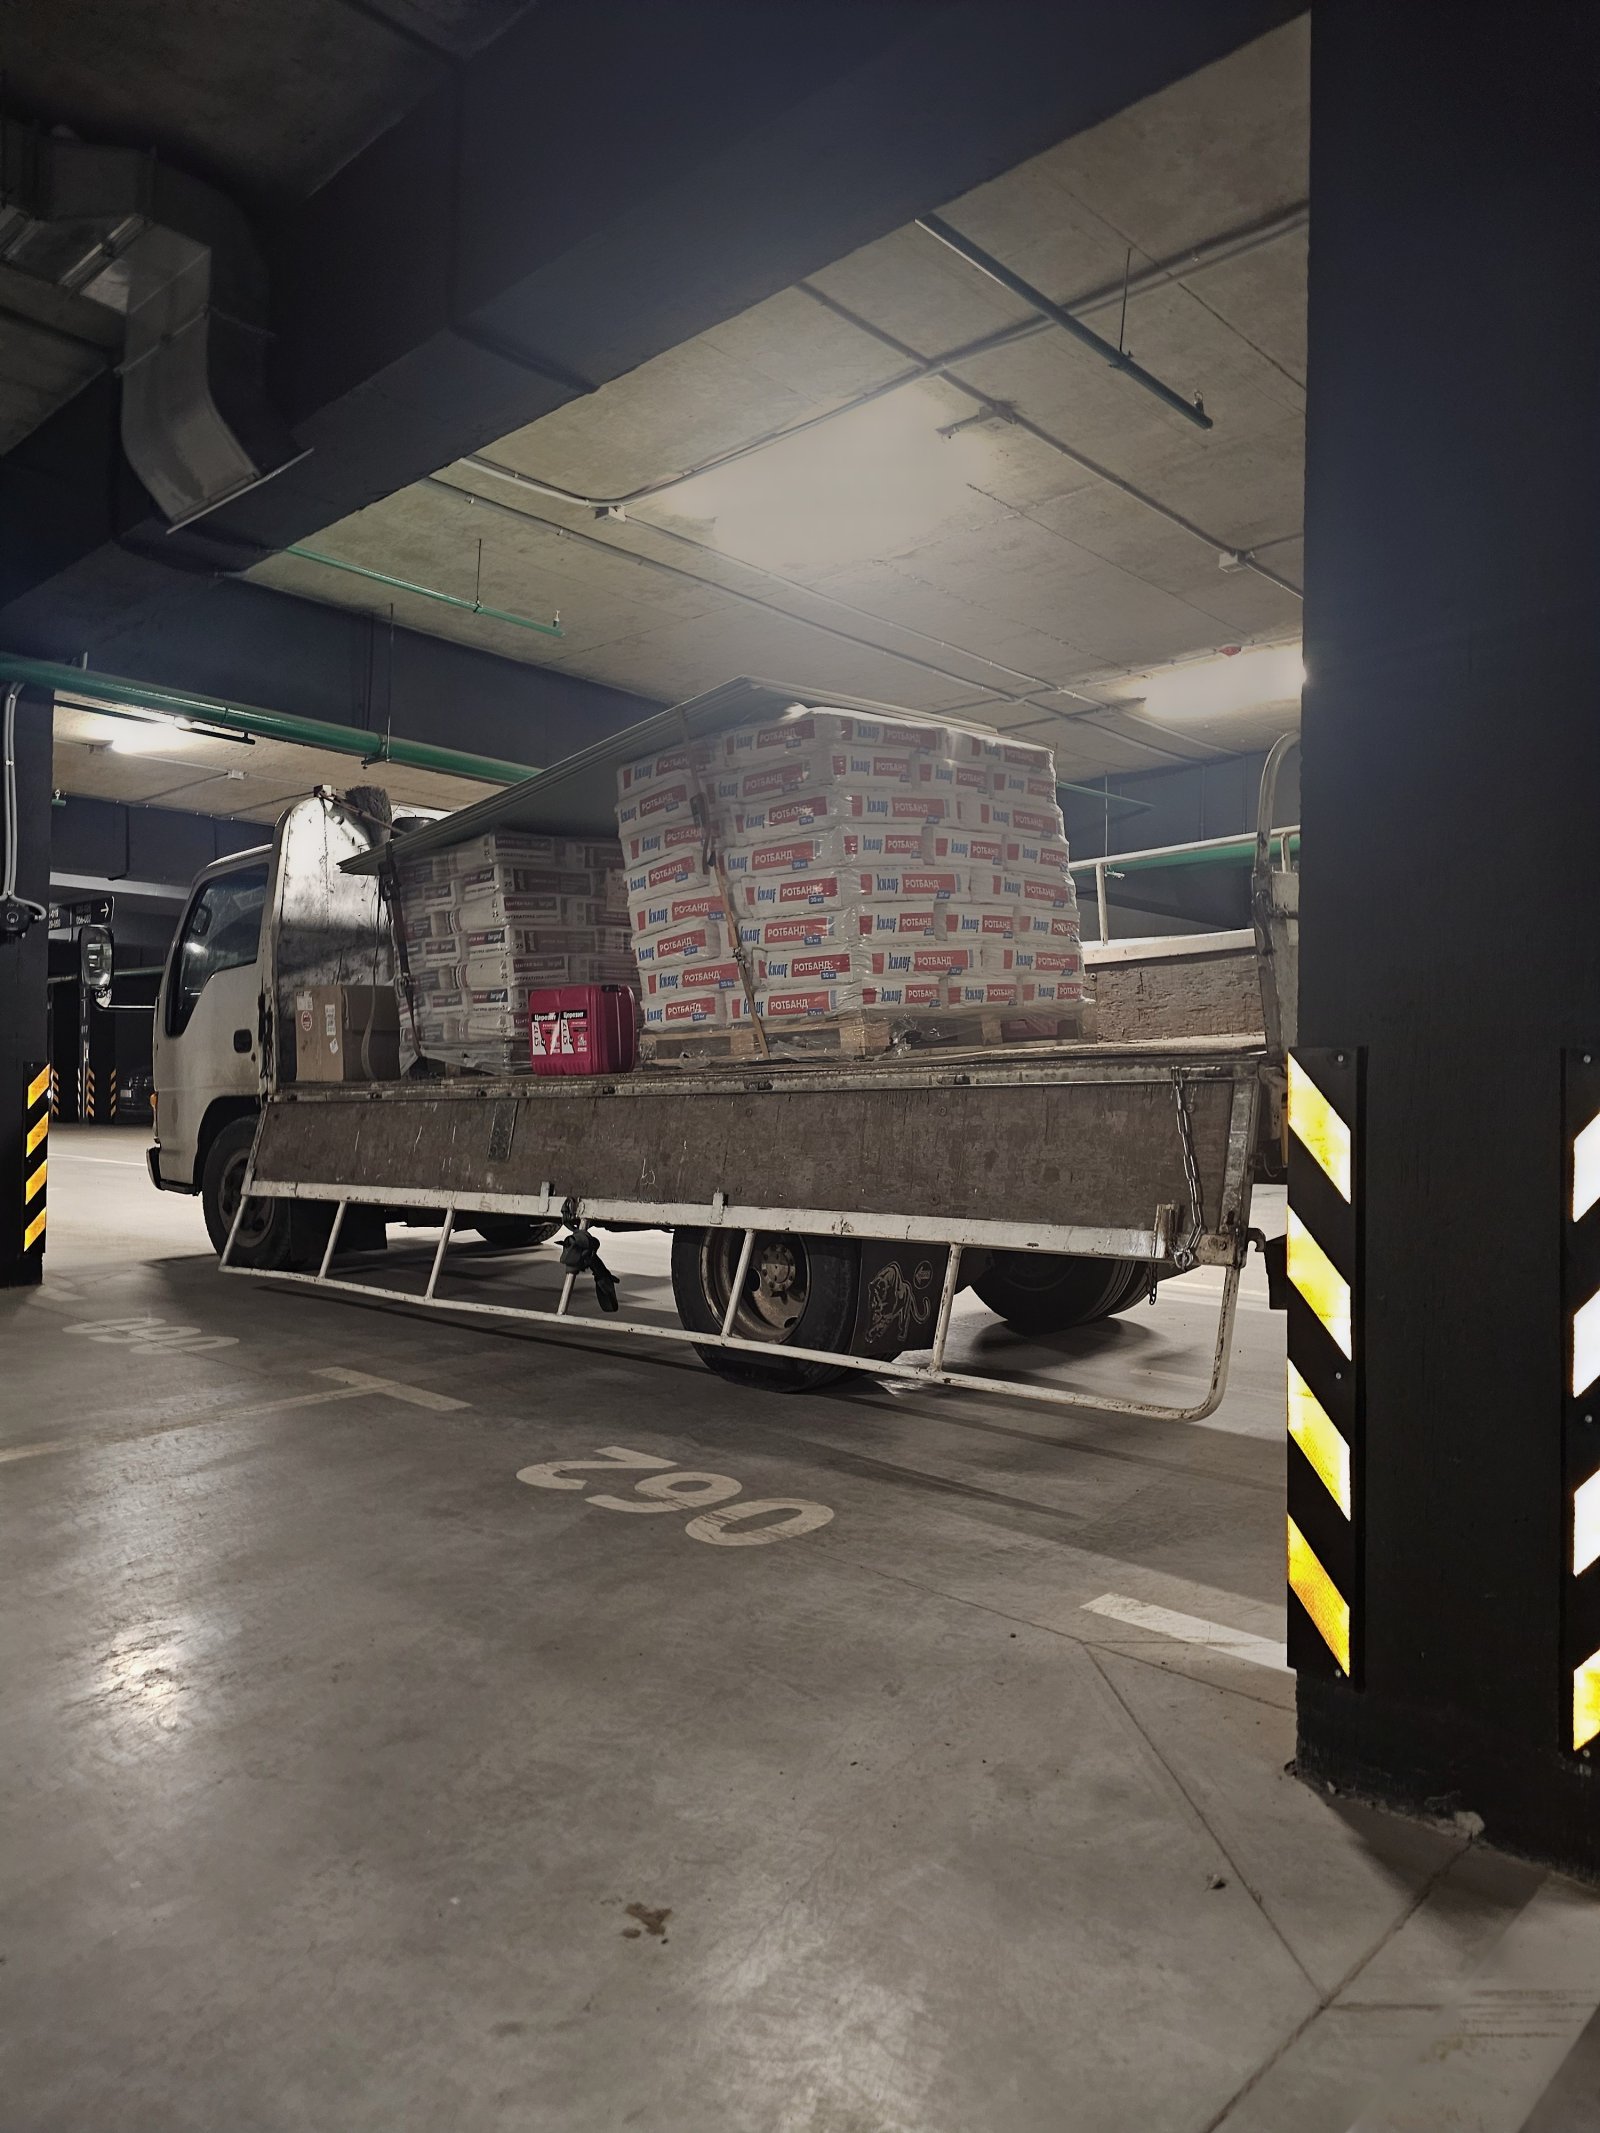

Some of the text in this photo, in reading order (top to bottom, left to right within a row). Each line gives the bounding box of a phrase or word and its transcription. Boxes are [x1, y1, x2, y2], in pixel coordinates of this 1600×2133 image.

[867, 796, 888, 816] KNAUF
[894, 803, 928, 814] РОТБАНД
[863, 835, 883, 854] KNAUF
[887, 840, 920, 850] РОТБАНД
[728, 854, 748, 872] KNAUF
[755, 849, 793, 864] РОТБАНД
[650, 863, 683, 882] РОТБАНД
[877, 874, 899, 894] KNAUF
[905, 879, 940, 889] РОТБАНД
[758, 886, 776, 903] KNAUF
[649, 908, 668, 923] KNAUF
[877, 914, 897, 933] KNAUF
[902, 918, 932, 927] РОТБАНД
[961, 914, 979, 933] KNAUF
[741, 926, 760, 944] KNAUF
[767, 925, 806, 938] РОТБАНД
[659, 936, 693, 953] РОТБАНД
[639, 947, 654, 961] KNAUF
[888, 952, 911, 972] KNAUF
[918, 957, 953, 967] РОТБАНД
[769, 962, 788, 978] KNAUF
[794, 961, 830, 973] РОТБАНД
[659, 973, 679, 989] KNAUF
[684, 970, 720, 982] РОТБАНД
[881, 987, 902, 1004] KNAUF
[908, 989, 937, 998] РОТБАНД
[965, 986, 984, 1003] KNAUF
[1038, 984, 1055, 1000] KNAUF
[668, 1002, 702, 1016] РОТБАНД
[770, 999, 808, 1010] РОТБАНД
[647, 1008, 663, 1022] KNAUF
